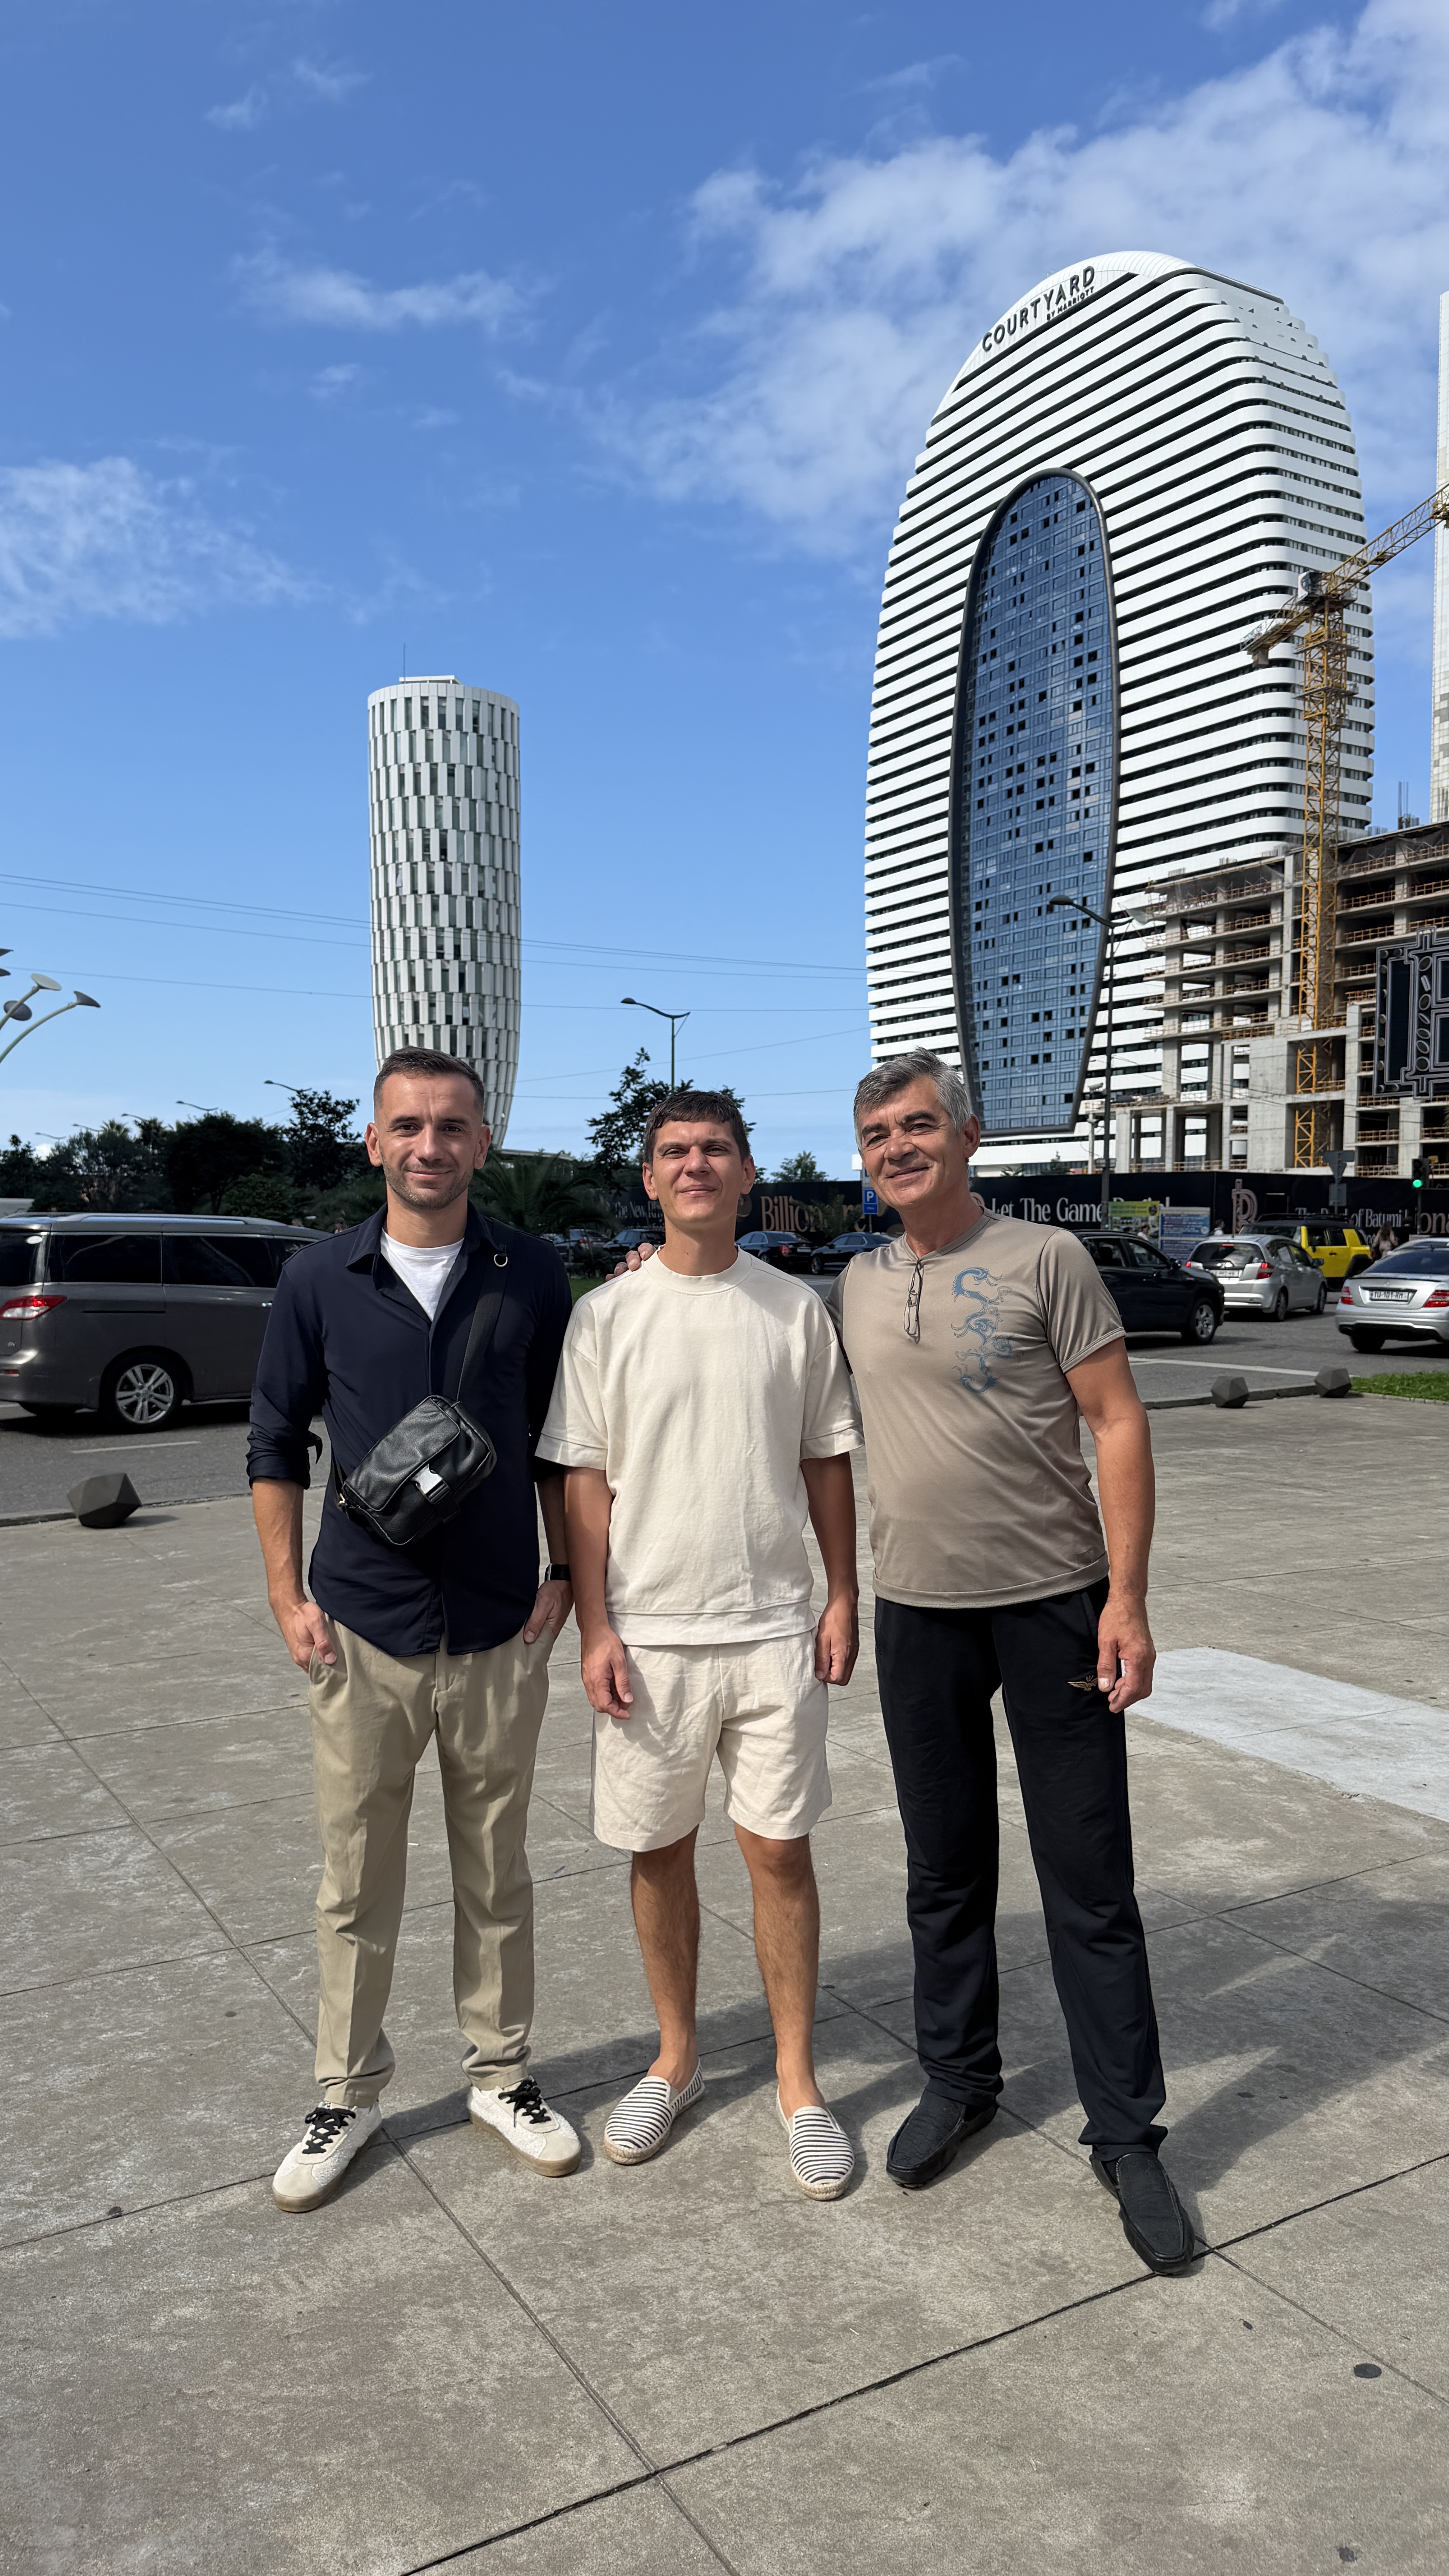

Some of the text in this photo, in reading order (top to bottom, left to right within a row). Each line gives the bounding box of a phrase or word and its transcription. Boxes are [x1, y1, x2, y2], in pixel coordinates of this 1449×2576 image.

[982, 266, 1095, 352] COURTYARD
[1047, 286, 1094, 321] BY MARRIOTT
[867, 1191, 874, 1202] P
[1020, 1198, 1052, 1222] The
[1351, 1209, 1365, 1227] of
[1366, 1208, 1402, 1228] Batumi
